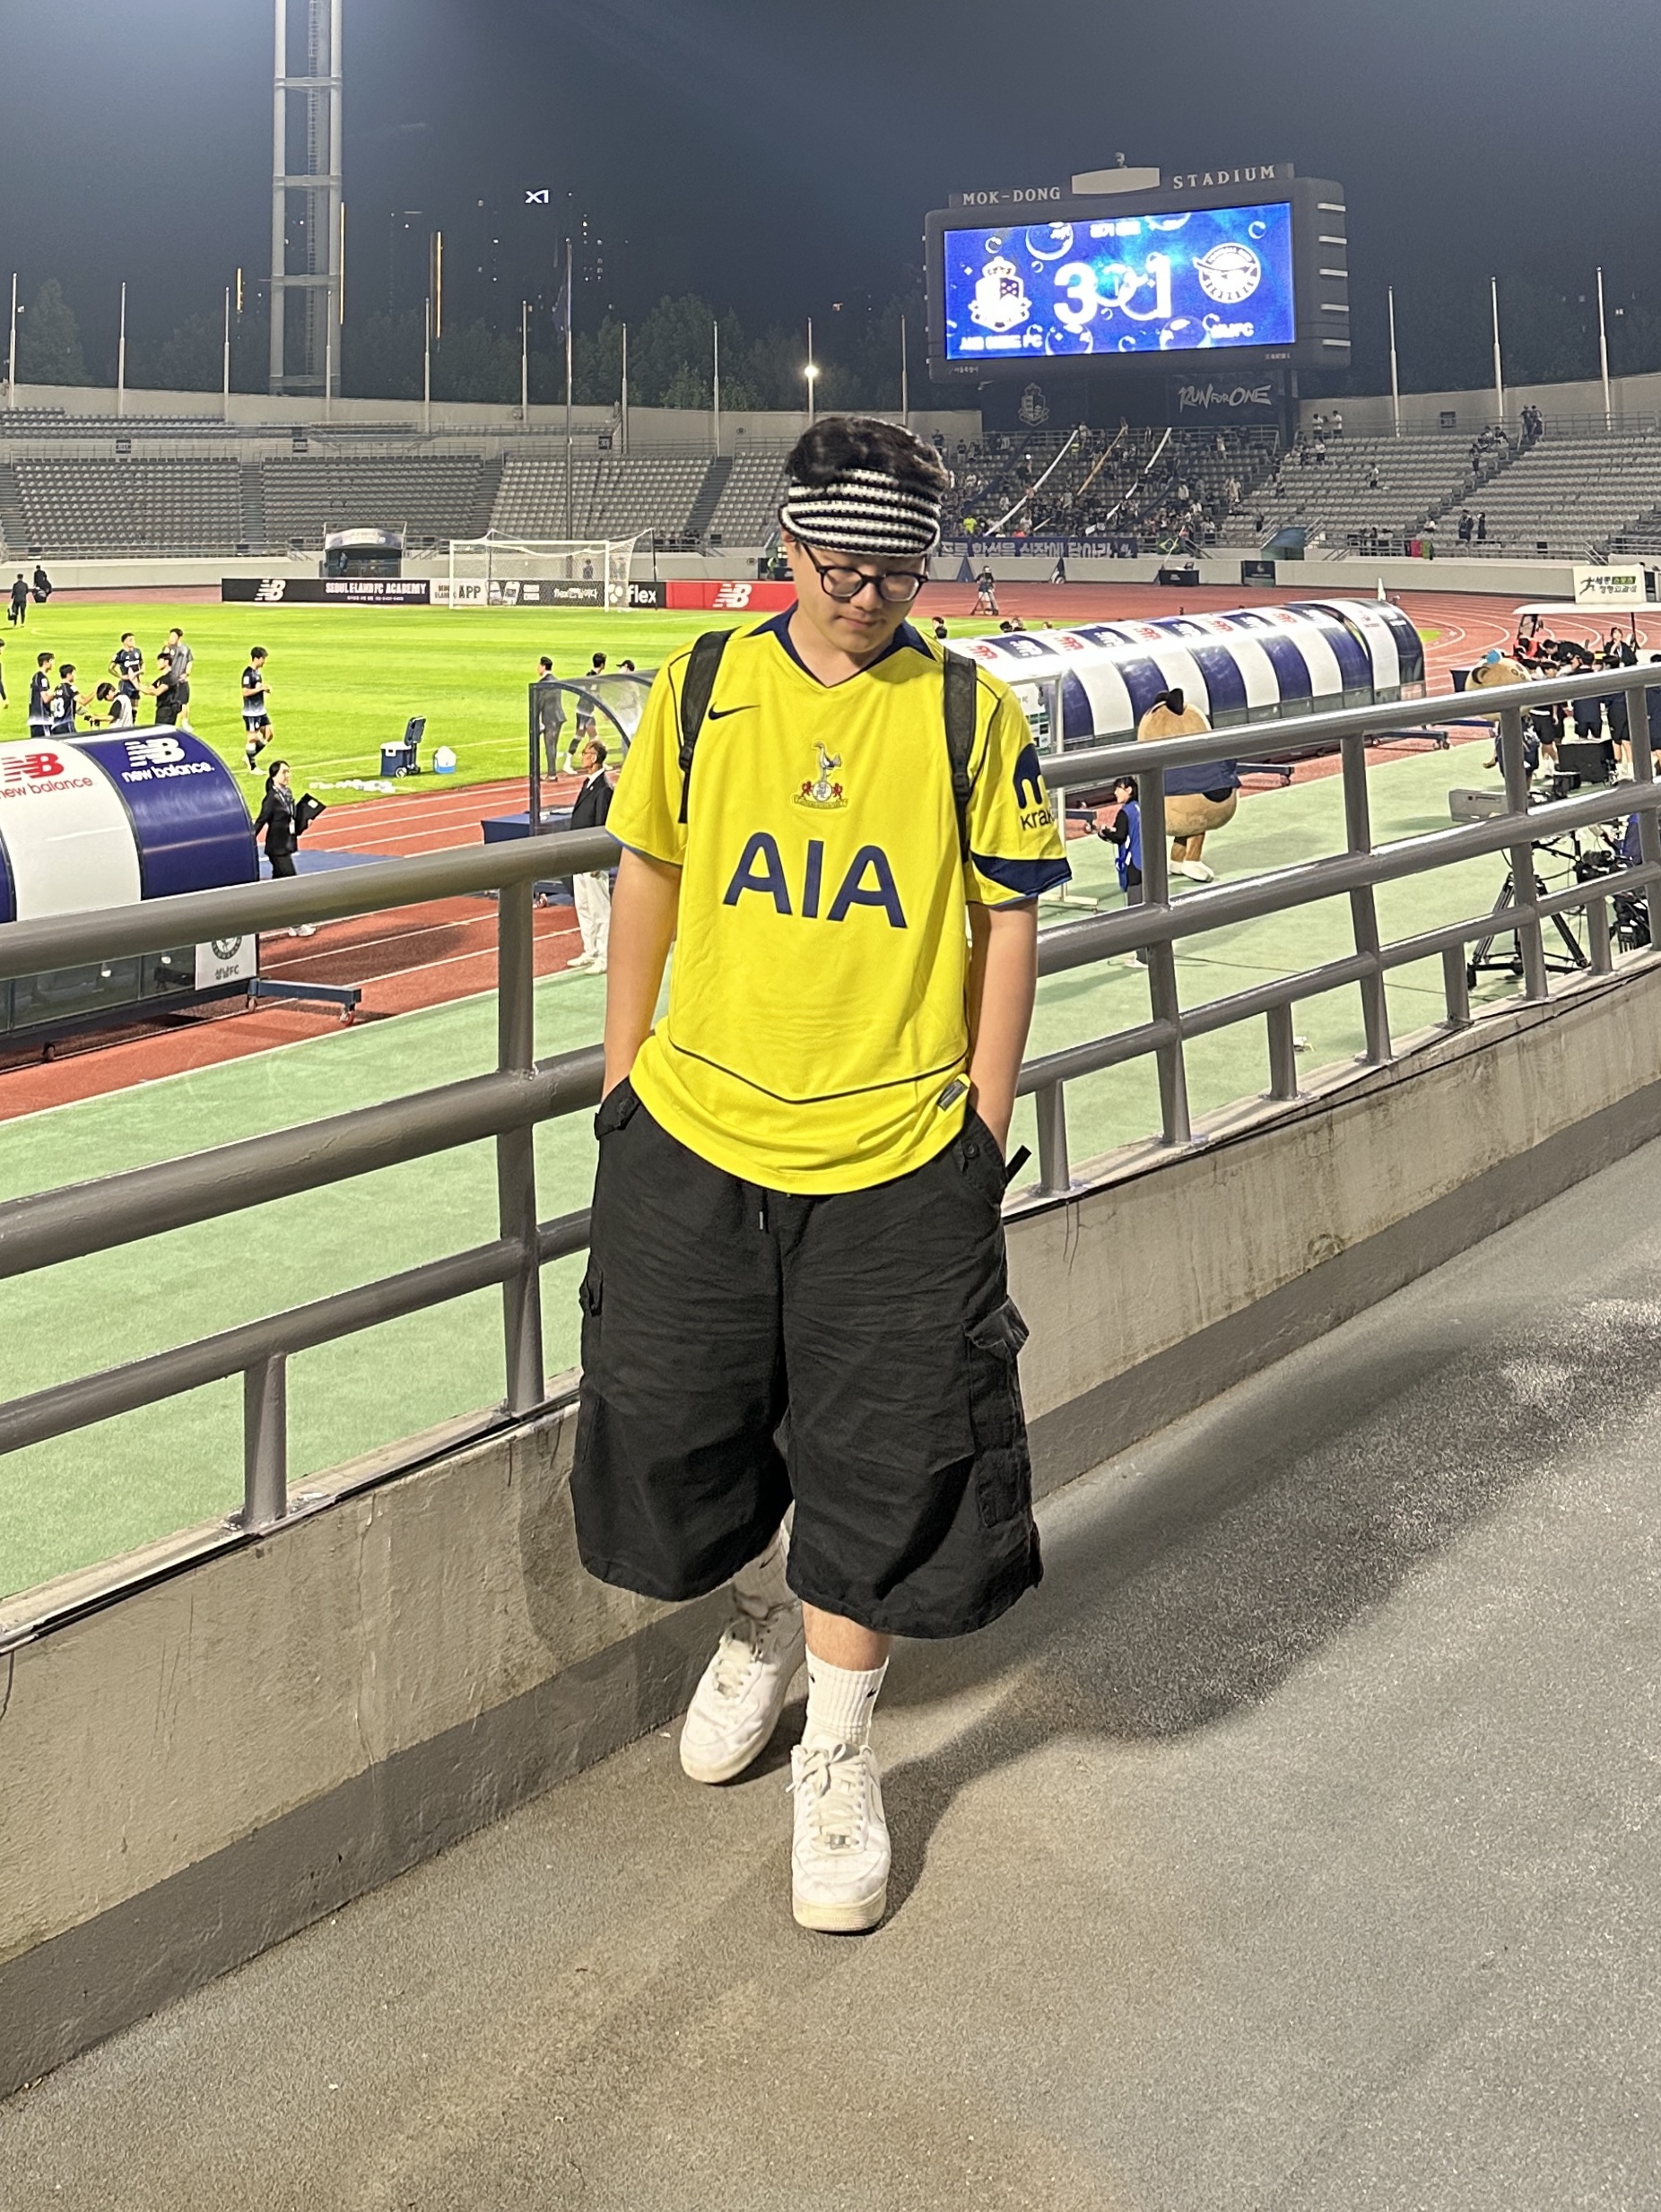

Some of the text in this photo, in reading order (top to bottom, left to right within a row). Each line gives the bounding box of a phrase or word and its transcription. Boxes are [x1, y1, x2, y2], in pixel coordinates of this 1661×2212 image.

[962, 164, 1275, 205] MOK-DONG STADIUM
[1053, 262, 1098, 325] 3
[1178, 383, 1213, 412] RUN
[1229, 385, 1272, 406] ONE
[326, 583, 349, 594] SEOUL
[385, 583, 427, 594] ACADEMY
[458, 585, 482, 600] APP
[627, 584, 657, 603] flex
[121, 768, 153, 783] new
[27, 777, 93, 794] balance
[722, 831, 909, 929] AIA
